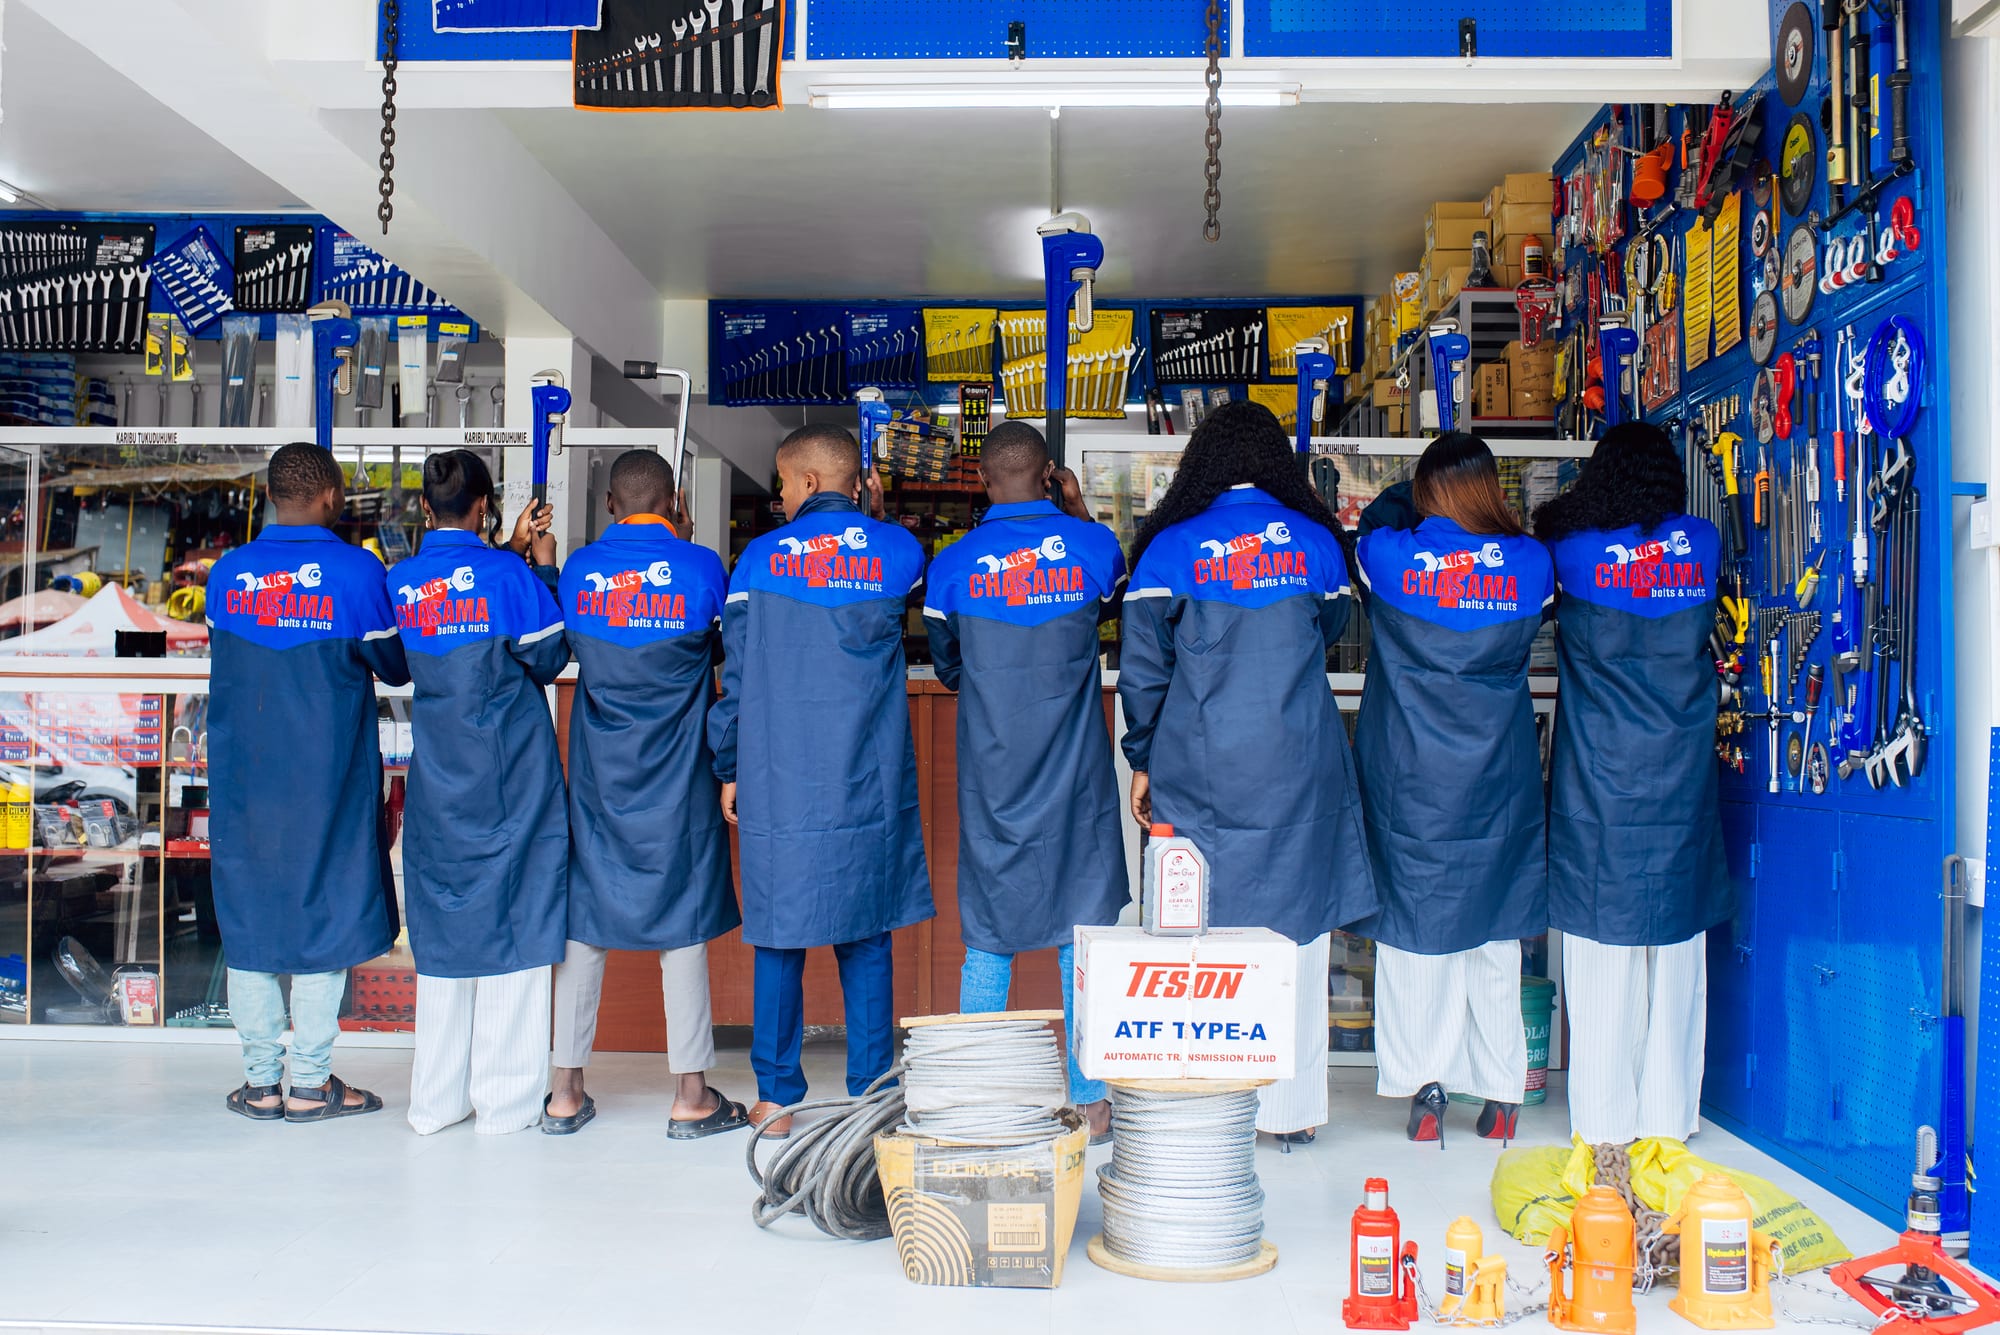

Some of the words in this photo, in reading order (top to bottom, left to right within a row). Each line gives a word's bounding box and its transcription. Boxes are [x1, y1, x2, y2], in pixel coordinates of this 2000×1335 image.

[116, 432, 136, 444] KARIBU
[464, 432, 486, 444] KARIBU
[770, 553, 882, 582] CHASAMA
[1194, 552, 1308, 584] CHASAMA
[969, 566, 1084, 598] CHASAMA
[1252, 578, 1278, 588] bolts
[1280, 577, 1287, 585] &
[1290, 576, 1308, 586] nuts
[1596, 562, 1705, 588] CHASAMA
[828, 580, 852, 589] bolts
[854, 581, 861, 590] &
[864, 582, 882, 592] nuts
[1402, 569, 1518, 601] CHASAMA
[1028, 594, 1052, 605] bolts
[1054, 594, 1061, 602] &
[1064, 592, 1084, 602] nuts
[1652, 588, 1675, 598] bolts
[1678, 588, 1684, 597] &
[1686, 588, 1706, 597] nuts
[227, 590, 334, 620] CHASAMA
[576, 590, 686, 619] CHASAMA
[1460, 599, 1484, 610] bolts
[1487, 601, 1494, 610] &
[1496, 602, 1517, 611] nuts
[396, 597, 490, 630] CHASAMA
[278, 617, 300, 628] bolts
[302, 620, 307, 628] &
[310, 620, 332, 631] nuts
[437, 624, 457, 635] bolts
[459, 625, 465, 633] &
[468, 623, 489, 633] nuts
[629, 618, 652, 628] bolts
[654, 620, 661, 628] &
[664, 620, 685, 630] nuts
[1126, 962, 1248, 1000] TESON
[1114, 1021, 1164, 1039] ATF
[1172, 1022, 1267, 1041] TYPE-A
[1104, 1052, 1163, 1062] AUTOMATIC
[1167, 1053, 1244, 1062] TRNSMISSION
[1247, 1054, 1276, 1063] FLUID
